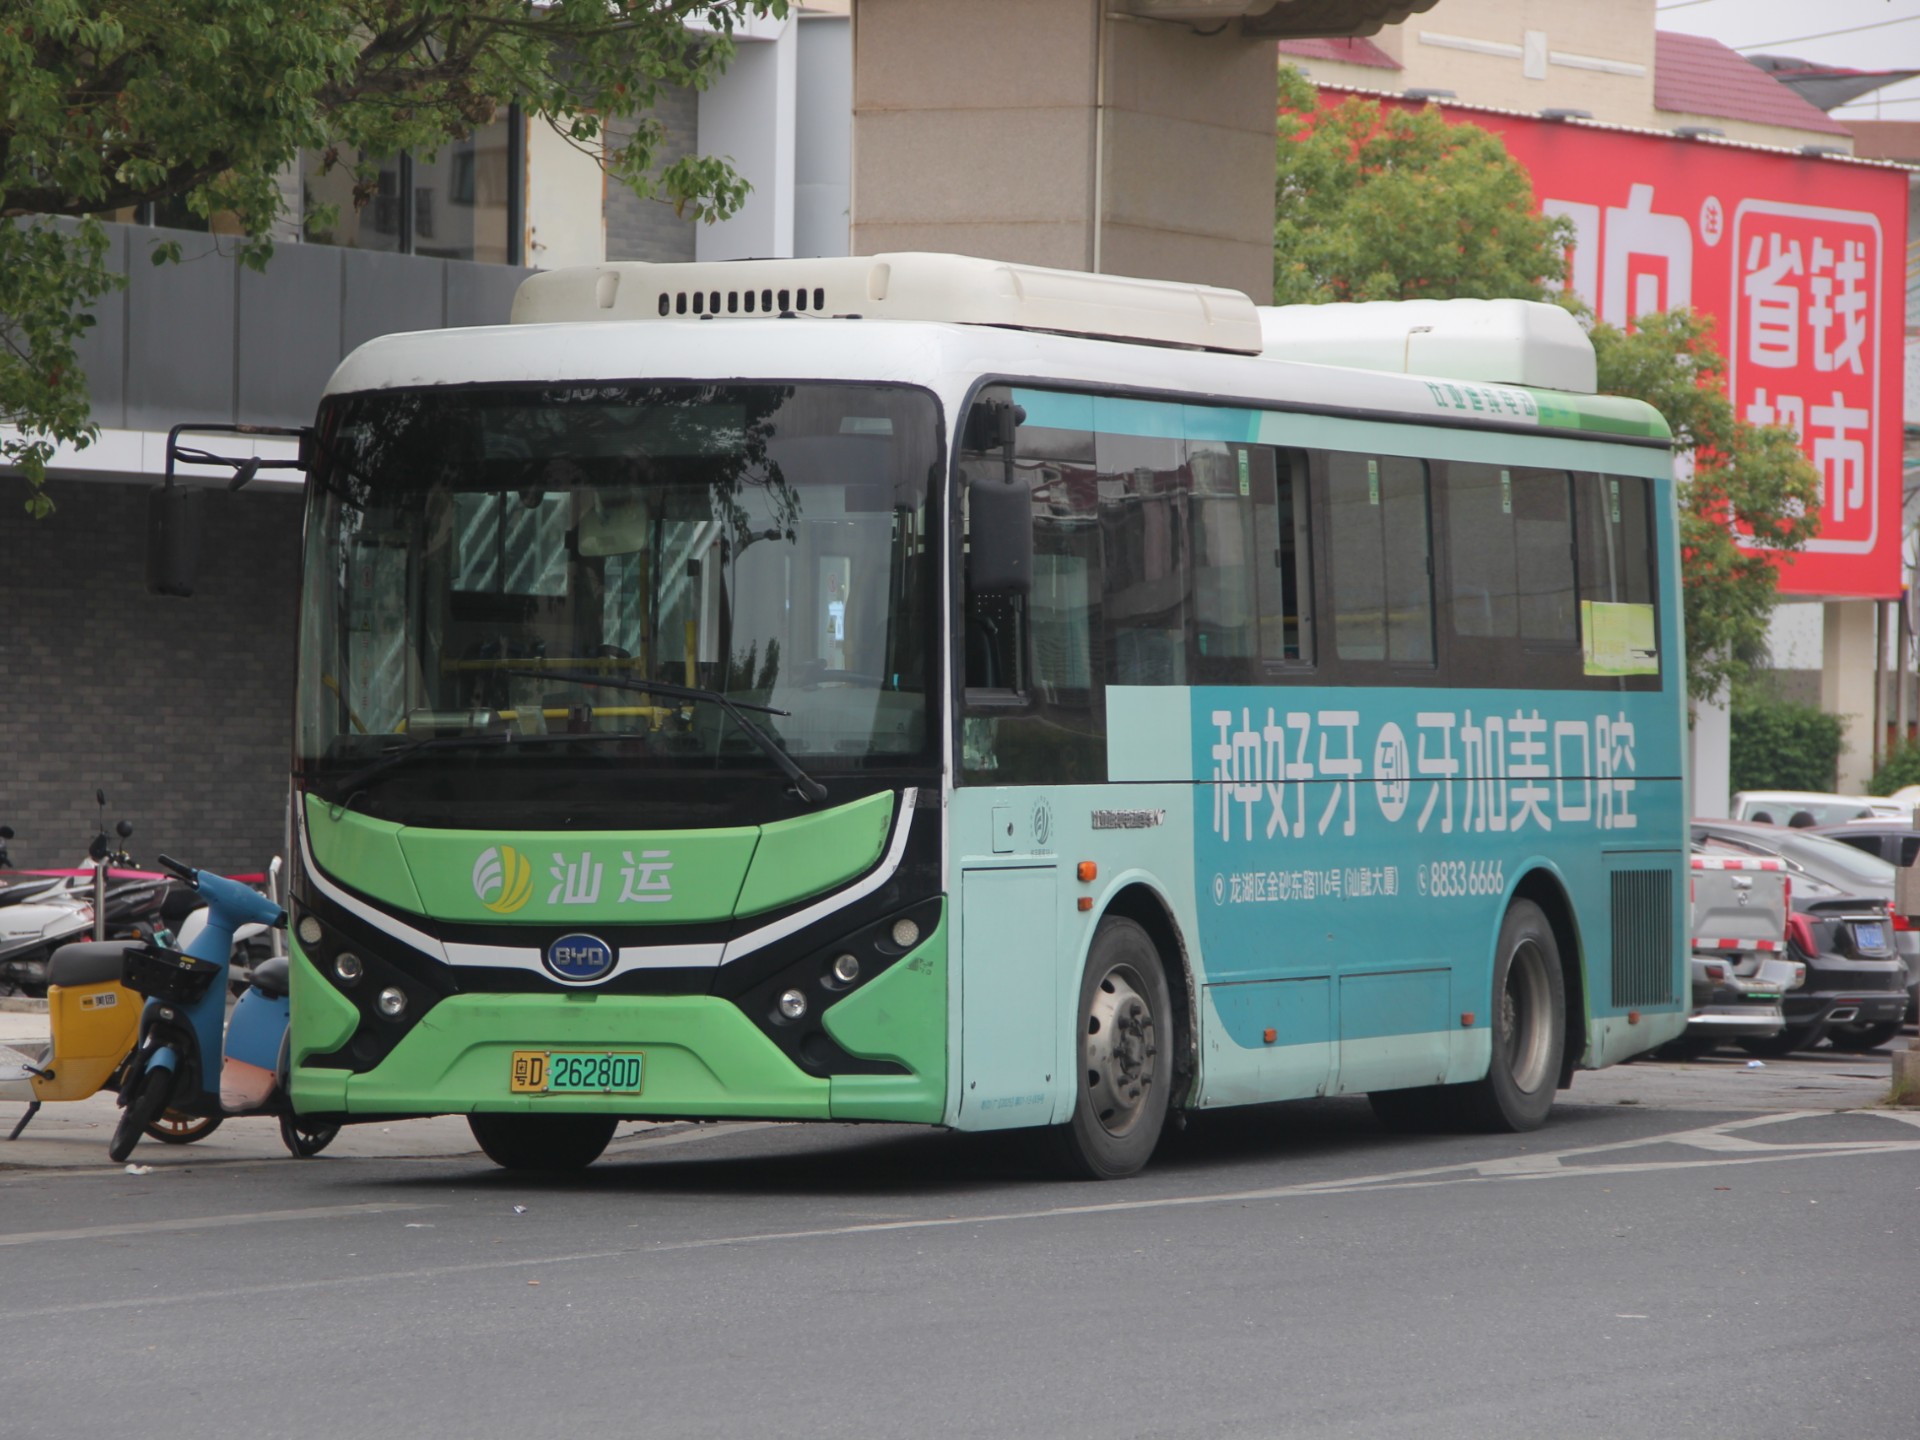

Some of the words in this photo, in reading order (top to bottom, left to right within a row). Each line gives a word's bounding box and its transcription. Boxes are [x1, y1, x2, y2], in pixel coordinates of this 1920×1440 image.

[1745, 232, 1867, 375] 省钱
[547, 850, 674, 904] 汕运
[555, 946, 604, 966] BYD
